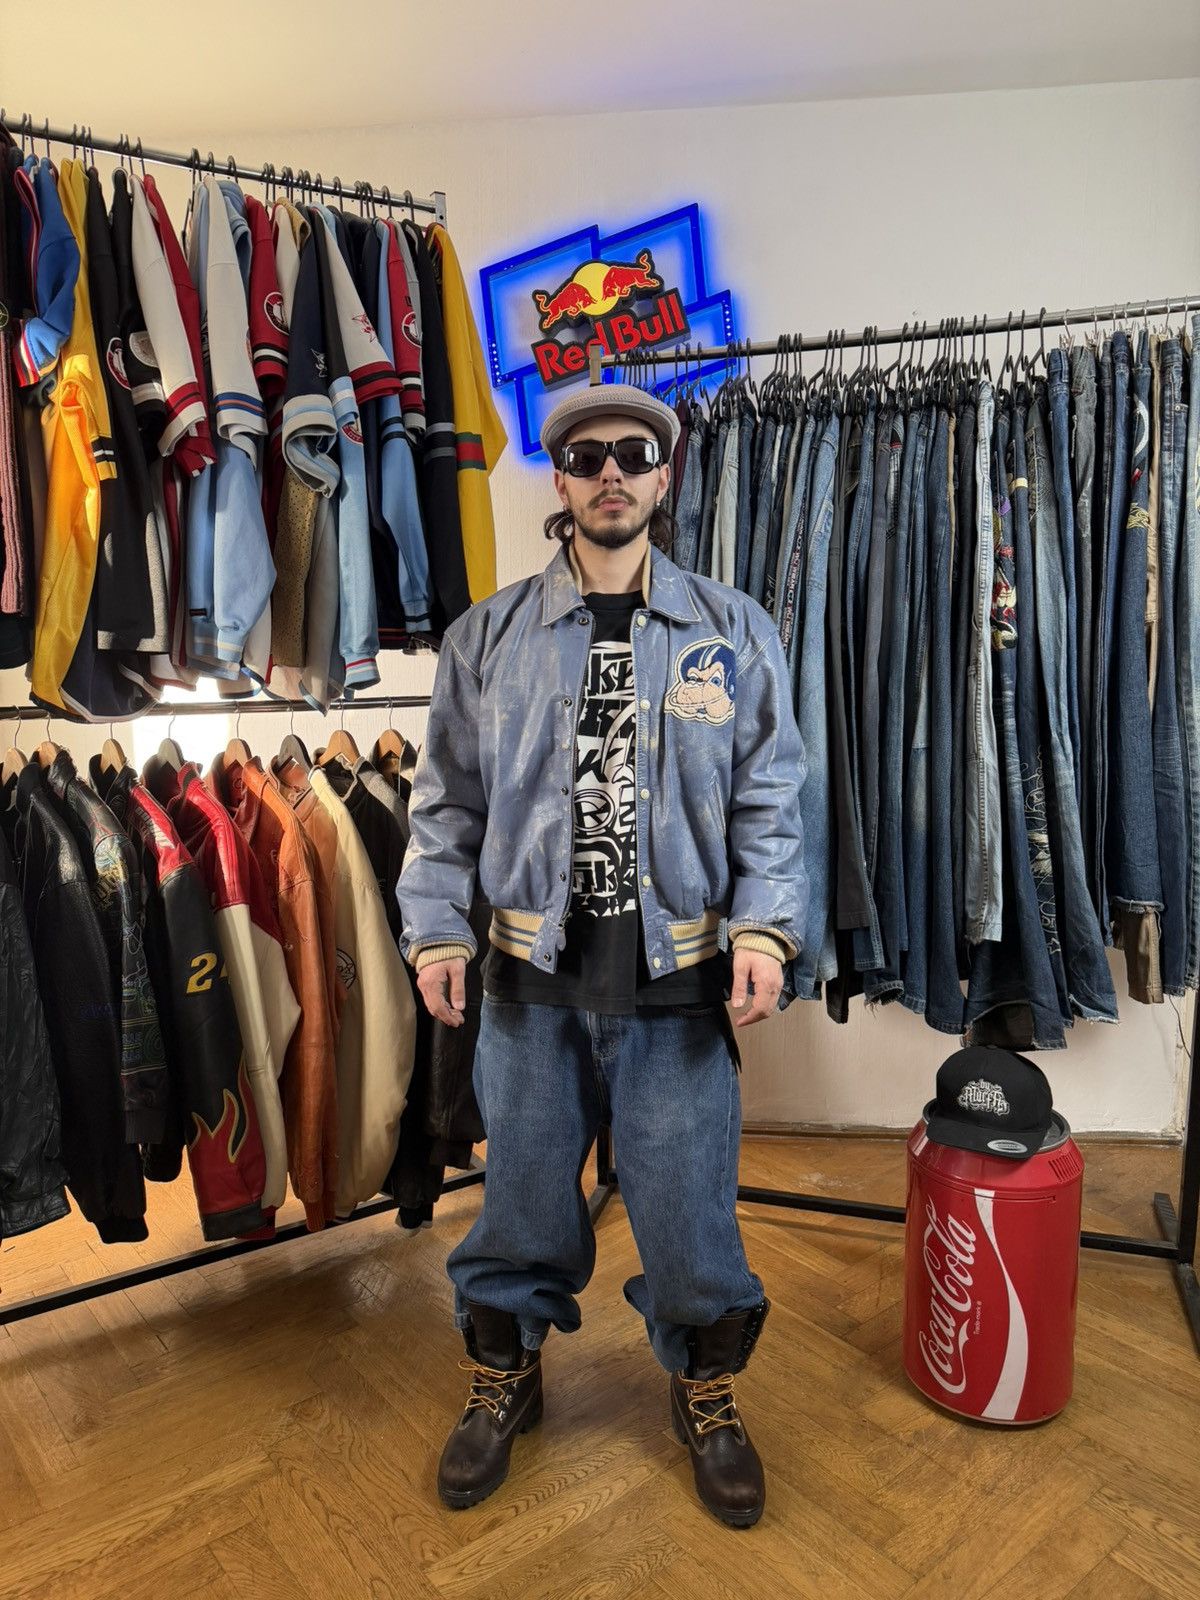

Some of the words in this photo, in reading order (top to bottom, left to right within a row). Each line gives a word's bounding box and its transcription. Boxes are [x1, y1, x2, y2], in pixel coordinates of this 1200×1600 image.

[535, 321, 611, 380] Red
[610, 293, 685, 353] Bull
[187, 952, 228, 993] 2
